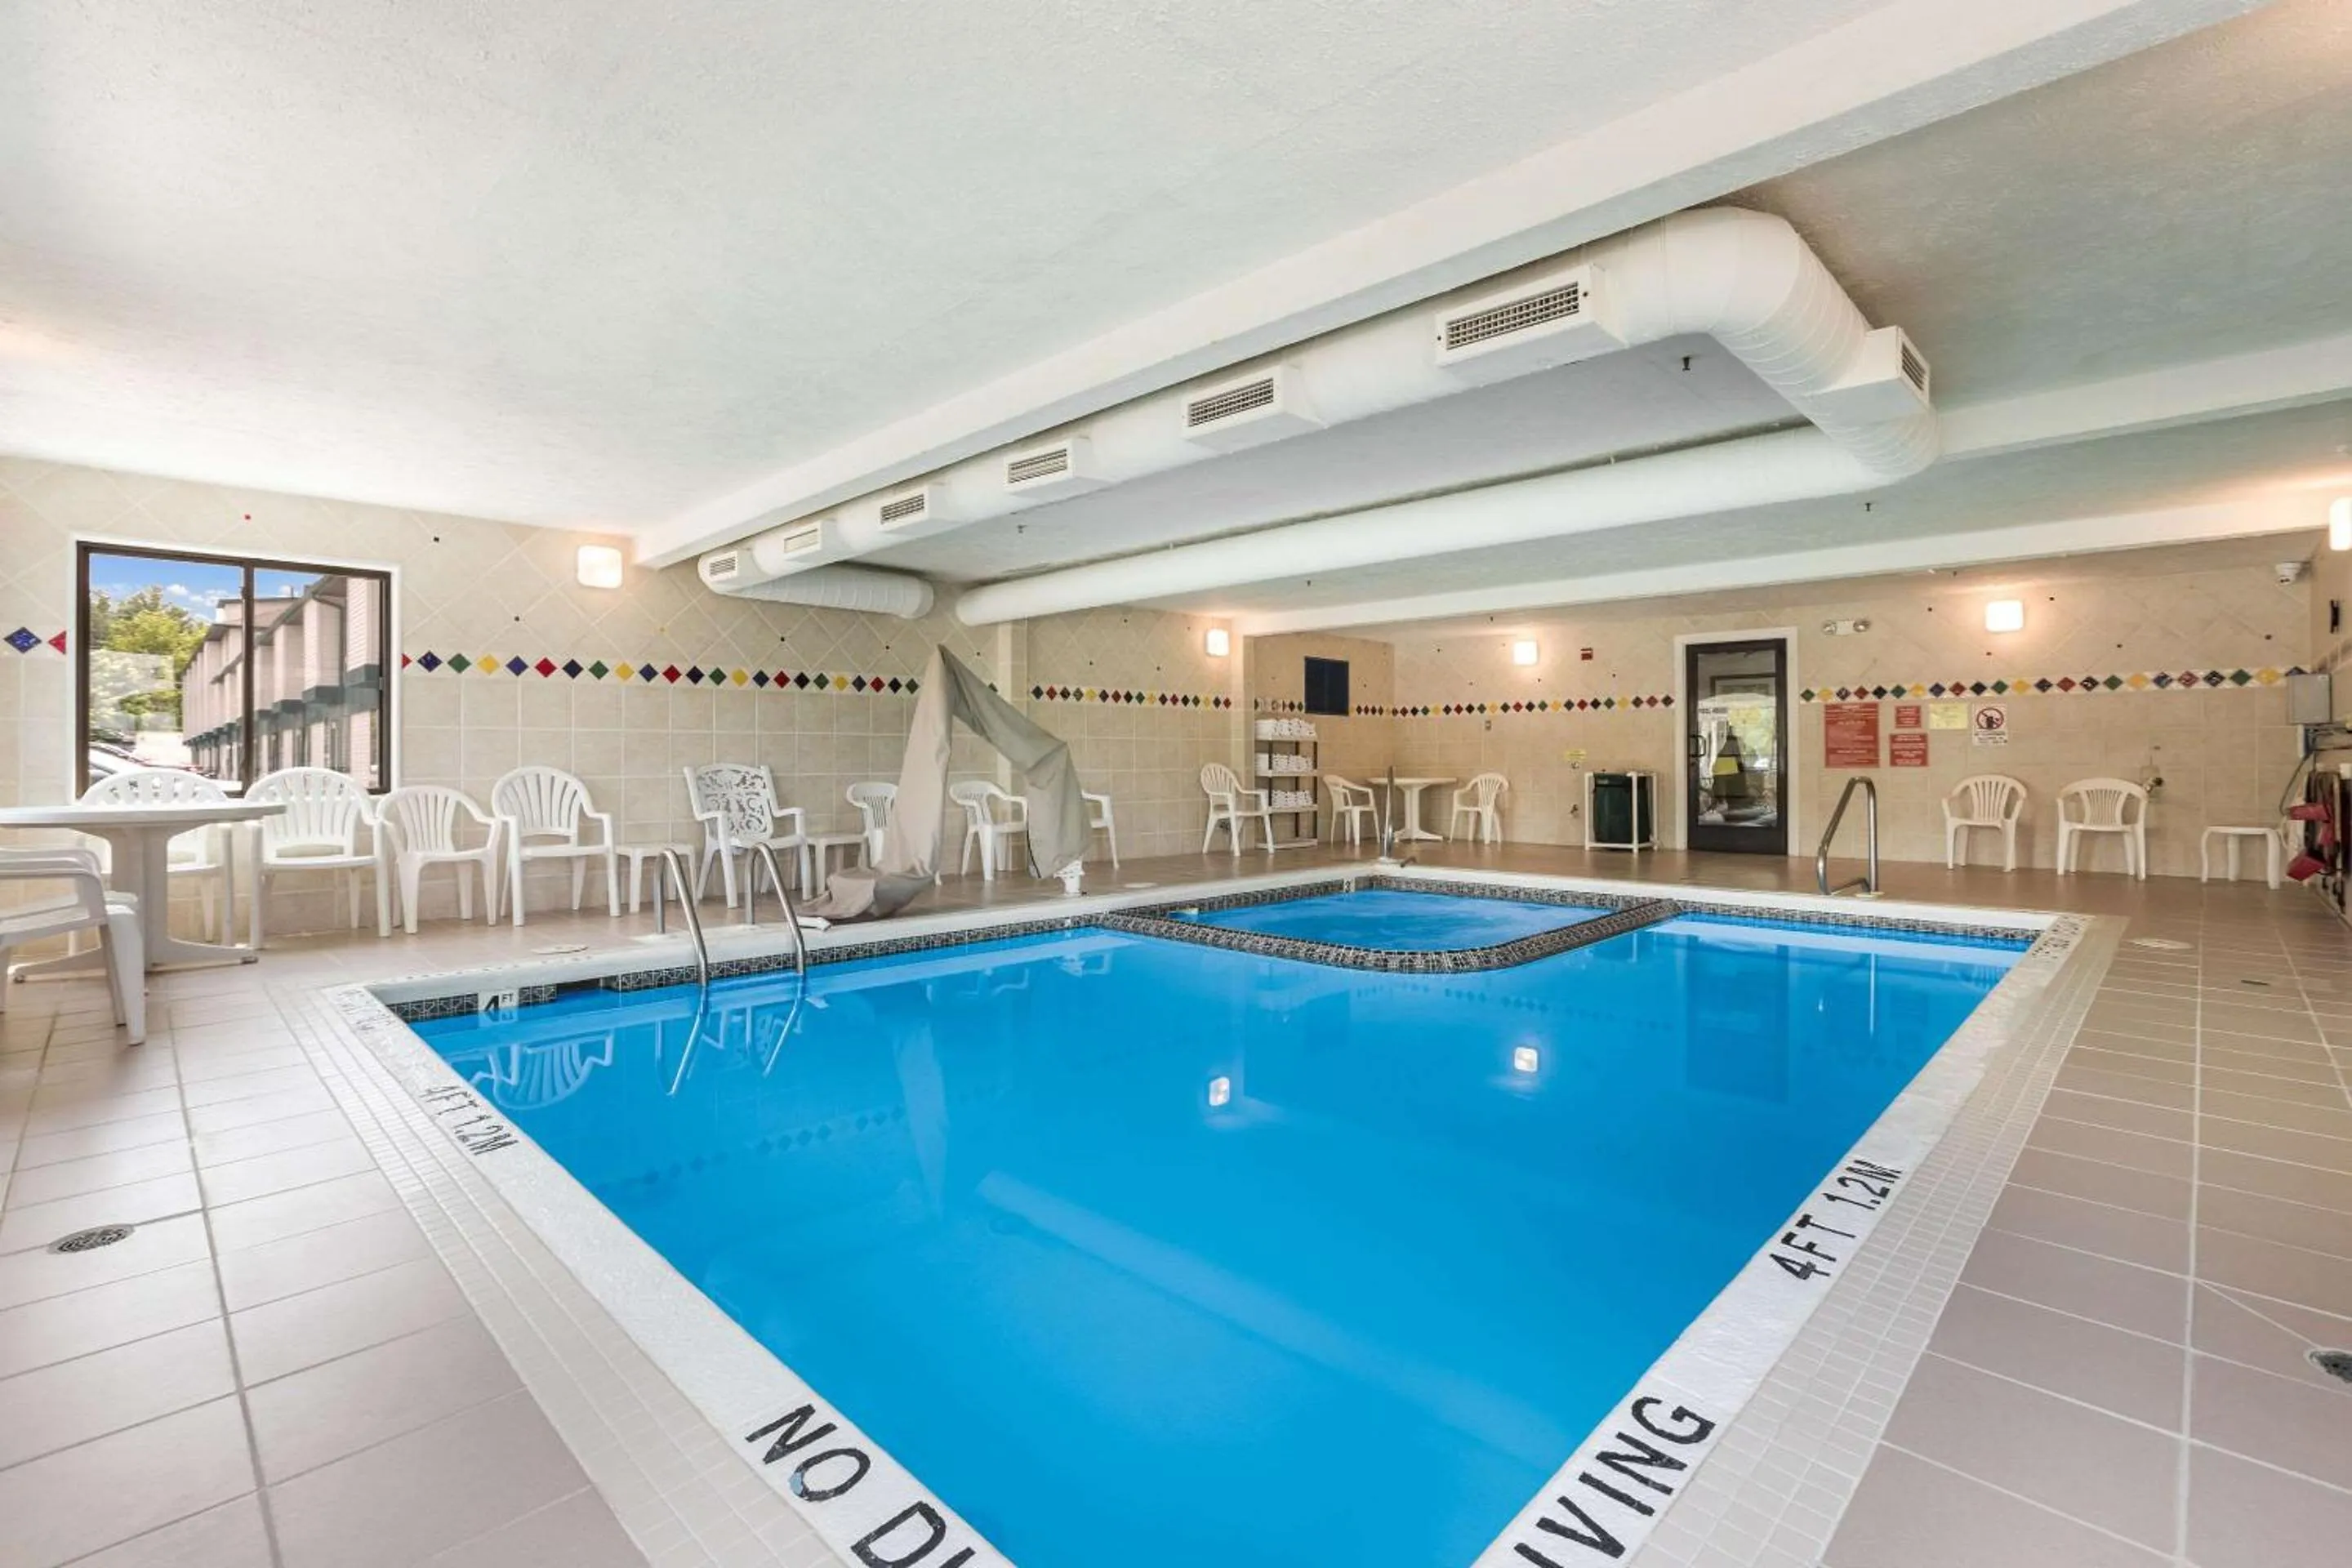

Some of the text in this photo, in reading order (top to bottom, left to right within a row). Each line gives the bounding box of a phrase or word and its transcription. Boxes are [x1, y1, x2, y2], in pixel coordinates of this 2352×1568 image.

[501, 993, 514, 1004] FT
[419, 1086, 519, 1156] 4FT 1.2M
[1769, 1159, 1903, 1281] 4FT 1.2M
[745, 1404, 871, 1502] NO
